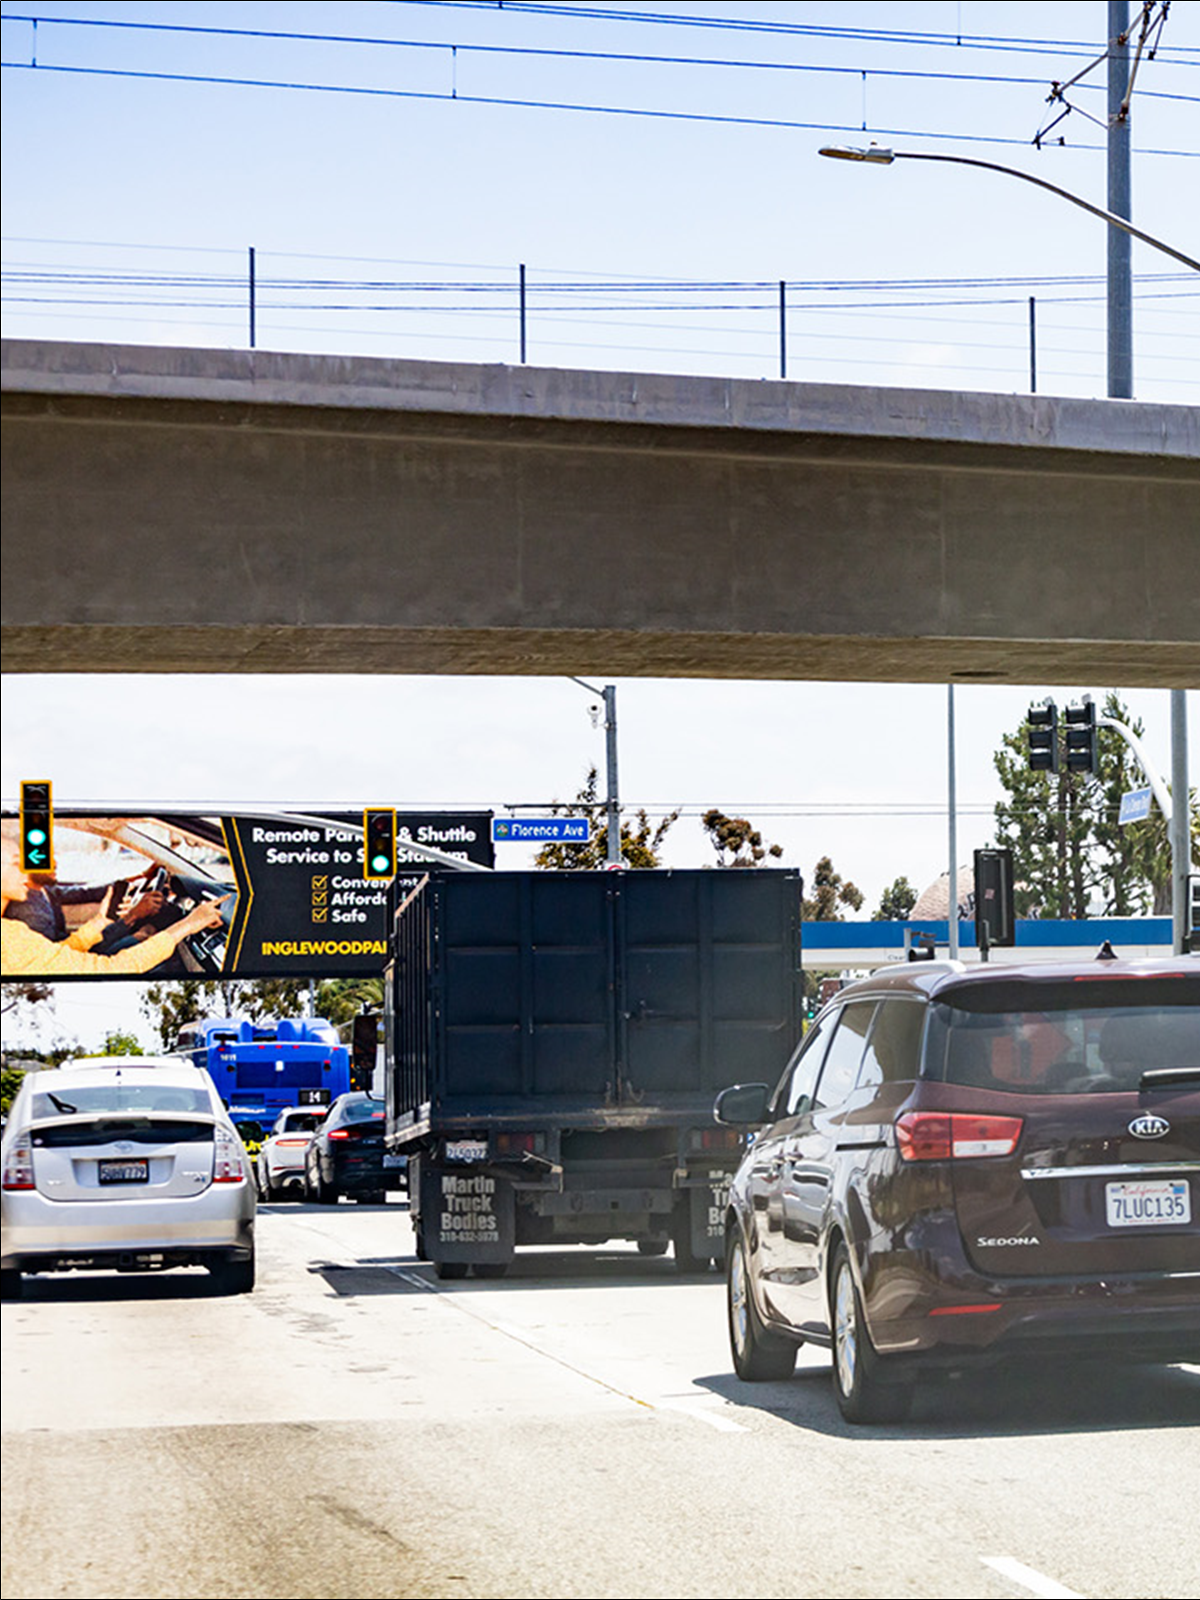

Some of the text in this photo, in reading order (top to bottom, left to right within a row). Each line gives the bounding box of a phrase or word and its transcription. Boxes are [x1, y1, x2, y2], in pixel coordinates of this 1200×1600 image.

[252, 827, 321, 843] Remote
[396, 826, 412, 842] &
[417, 825, 477, 842] Shuttle
[511, 823, 584, 836] Florence Ave
[266, 848, 329, 863] Service
[333, 849, 352, 863] to
[397, 846, 469, 863] Stadm
[331, 875, 419, 889] Convennt
[331, 908, 367, 922] Safe
[1136, 1120, 1164, 1134] KIA
[442, 1175, 495, 1193] Martin
[445, 1194, 492, 1211] Truck
[1113, 1196, 1185, 1219] 7LUC135
[441, 1212, 497, 1229] Bodies
[977, 1236, 1040, 1248] SEDONA
